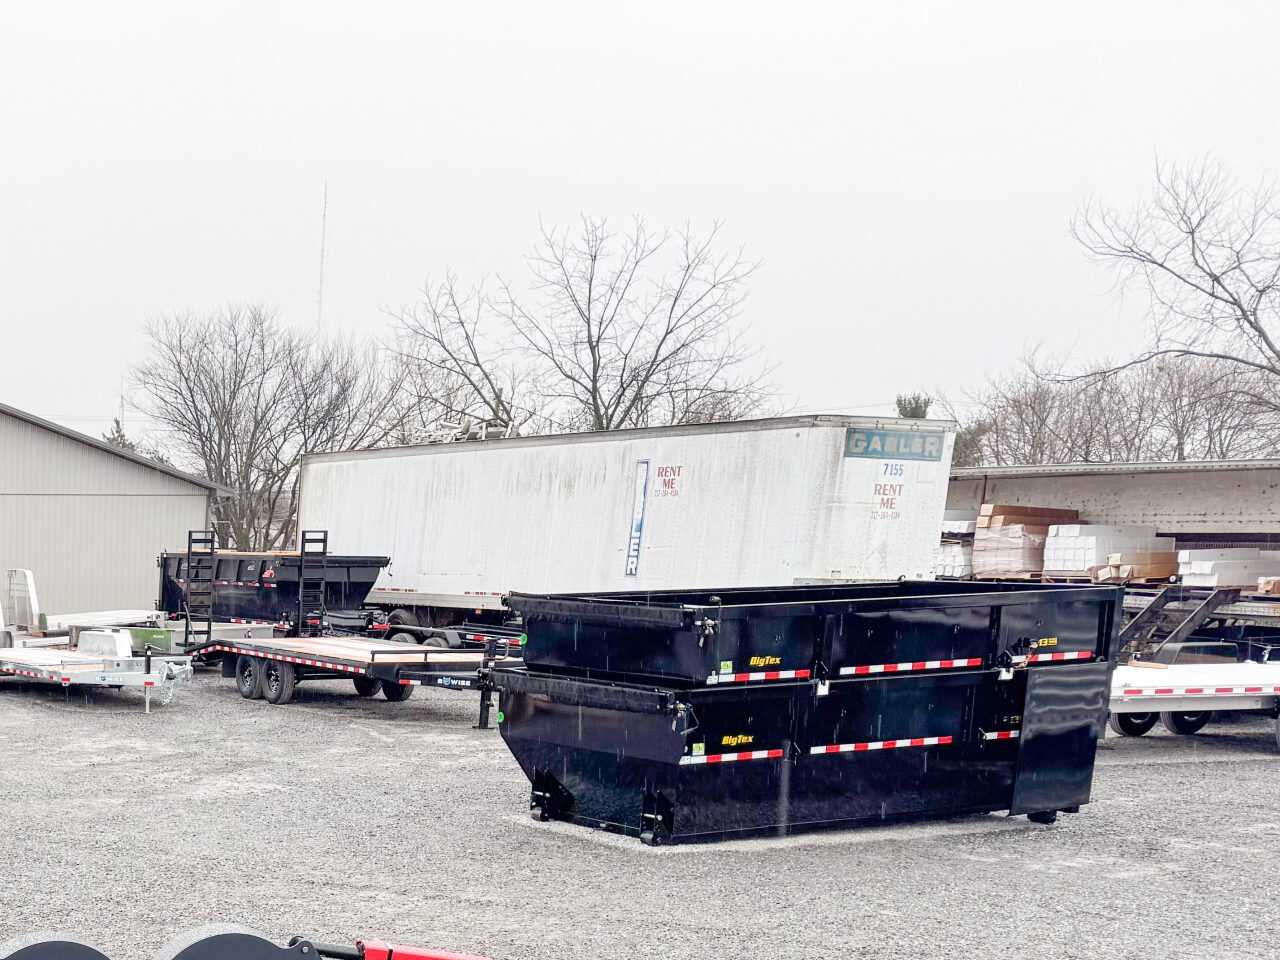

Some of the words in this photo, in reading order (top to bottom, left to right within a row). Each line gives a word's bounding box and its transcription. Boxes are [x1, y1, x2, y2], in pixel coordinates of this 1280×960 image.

[657, 465, 683, 478] RENT
[663, 478, 676, 489] ME
[874, 483, 904, 496] RENT
[880, 497, 896, 509] ME
